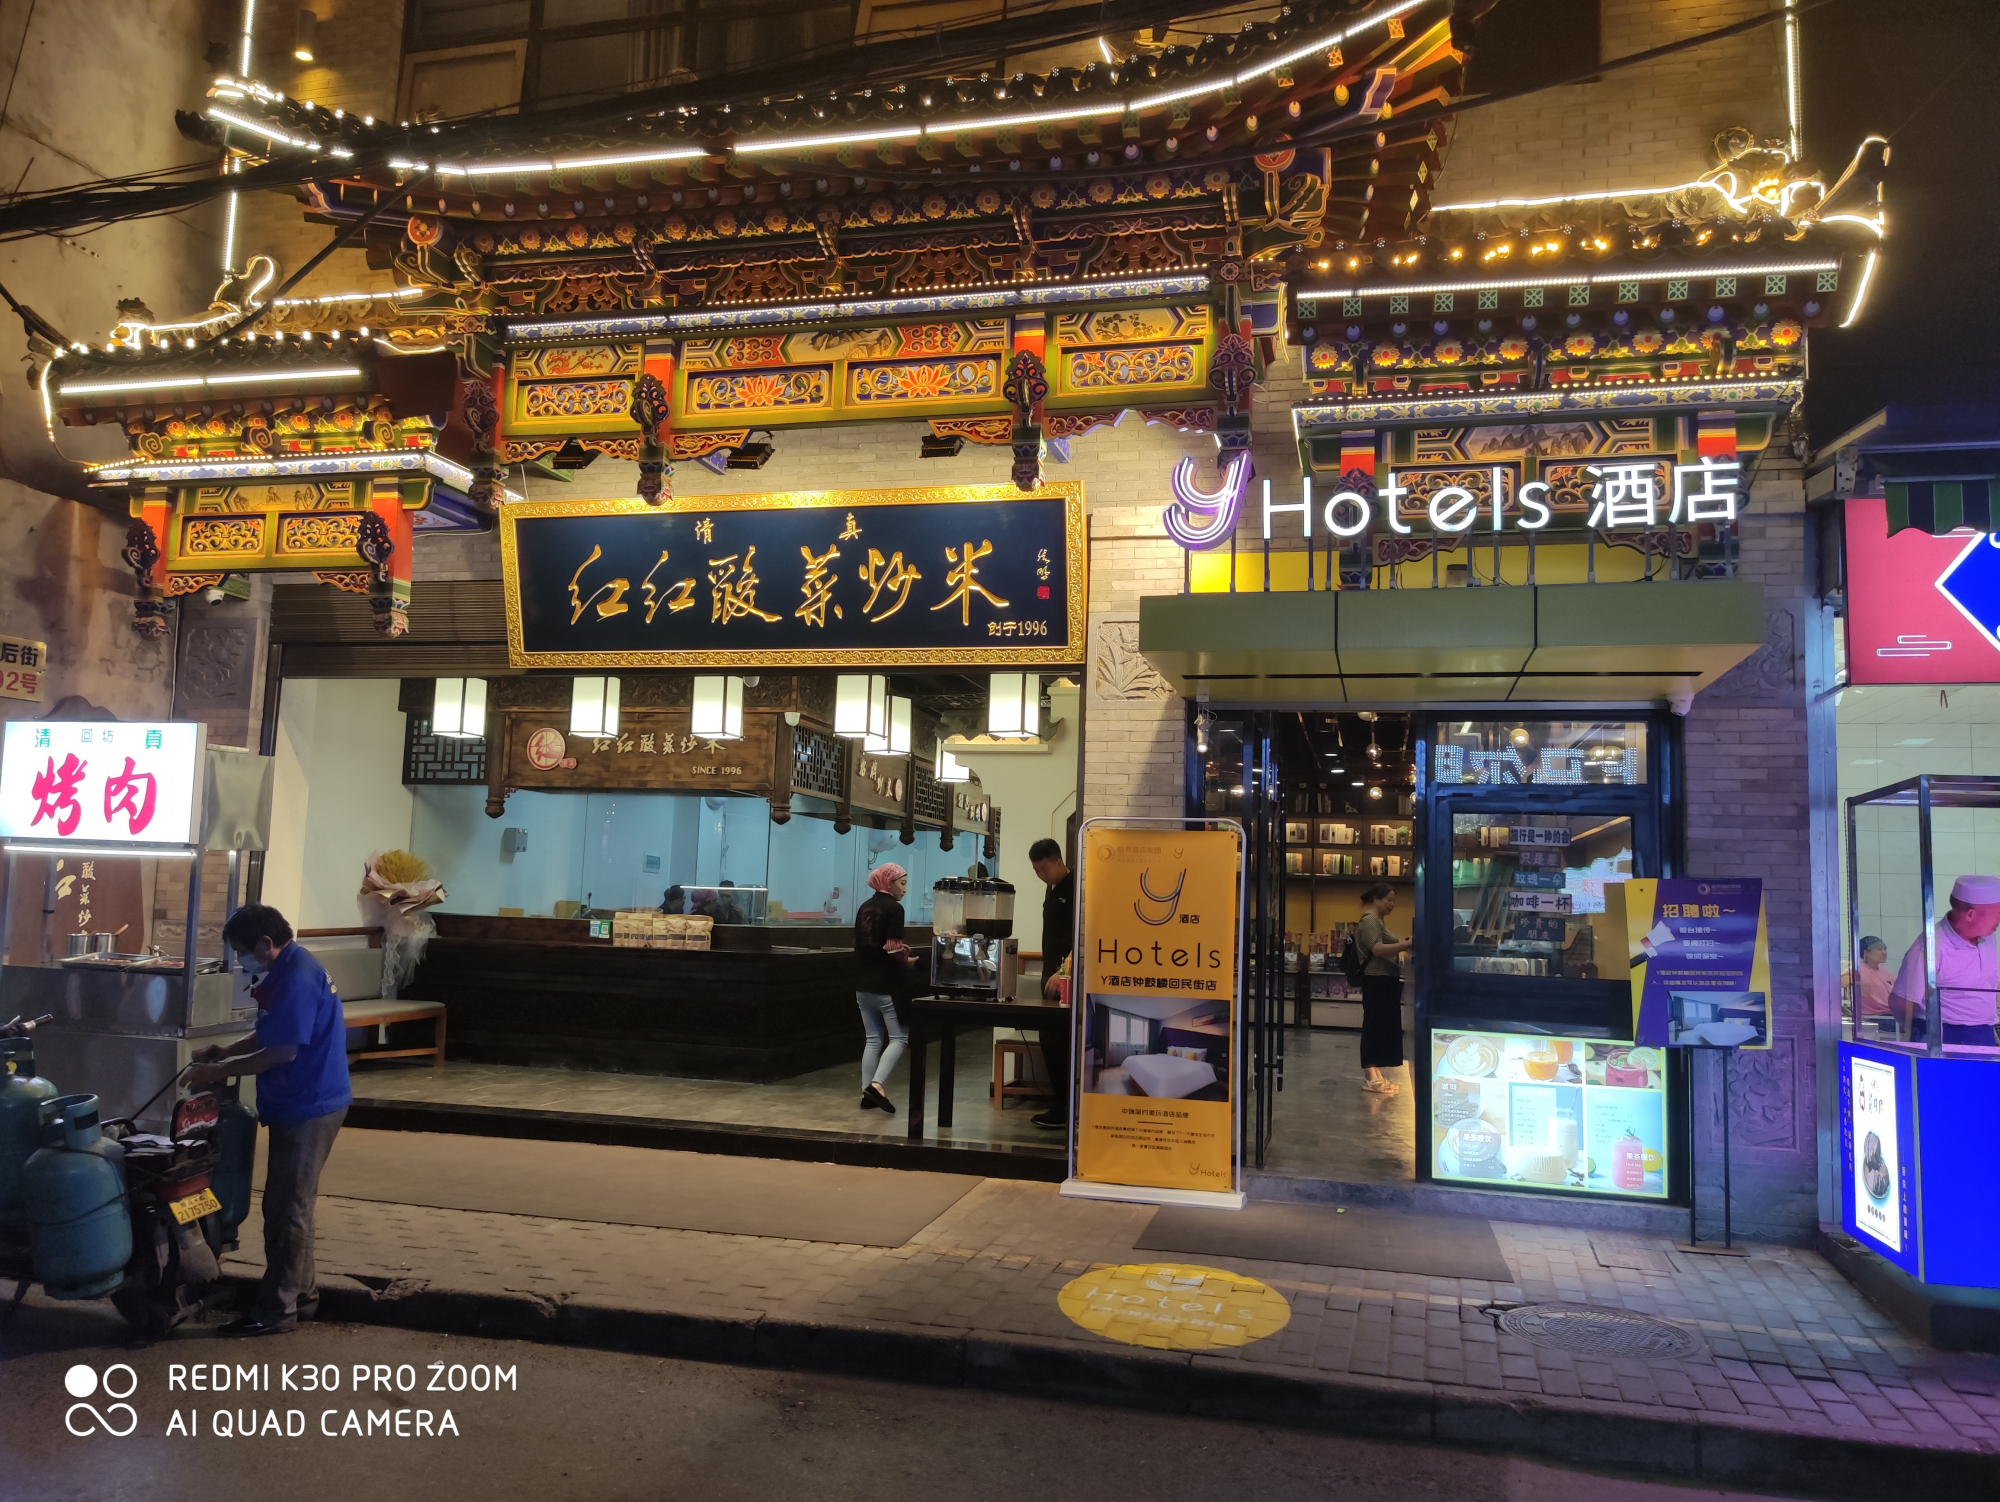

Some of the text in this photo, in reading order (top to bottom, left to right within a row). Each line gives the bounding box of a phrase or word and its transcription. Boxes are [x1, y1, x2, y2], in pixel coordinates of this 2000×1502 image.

[1262, 467, 1552, 539] Hotels
[1584, 456, 1740, 529] 酒店
[839, 512, 862, 540] 真
[568, 539, 1009, 626] 红红酸菜炒米
[987, 620, 1048, 636] 创于1996
[0, 643, 38, 667] 后街
[0, 671, 38, 694] 2号
[34, 728, 51, 748] 清
[81, 729, 114, 743] 回坊
[691, 766, 742, 775] SINCE 1996
[30, 753, 157, 836] 烤肉
[1510, 828, 1571, 844] 旅行是一种约会
[1515, 873, 1563, 886] 玫瑰一朵
[78, 861, 96, 935] 酸菜炒
[1509, 894, 1571, 911] 咖啡一杯
[1179, 914, 1200, 924] 酒店
[1519, 917, 1559, 929] 珍贵的
[1526, 930, 1551, 940] 朋友
[1098, 939, 1221, 969] Hotels
[1200, 1169, 1227, 1178] Hotels
[177, 1199, 218, 1222] 2175750
[1085, 1287, 1253, 1320] Hotels
